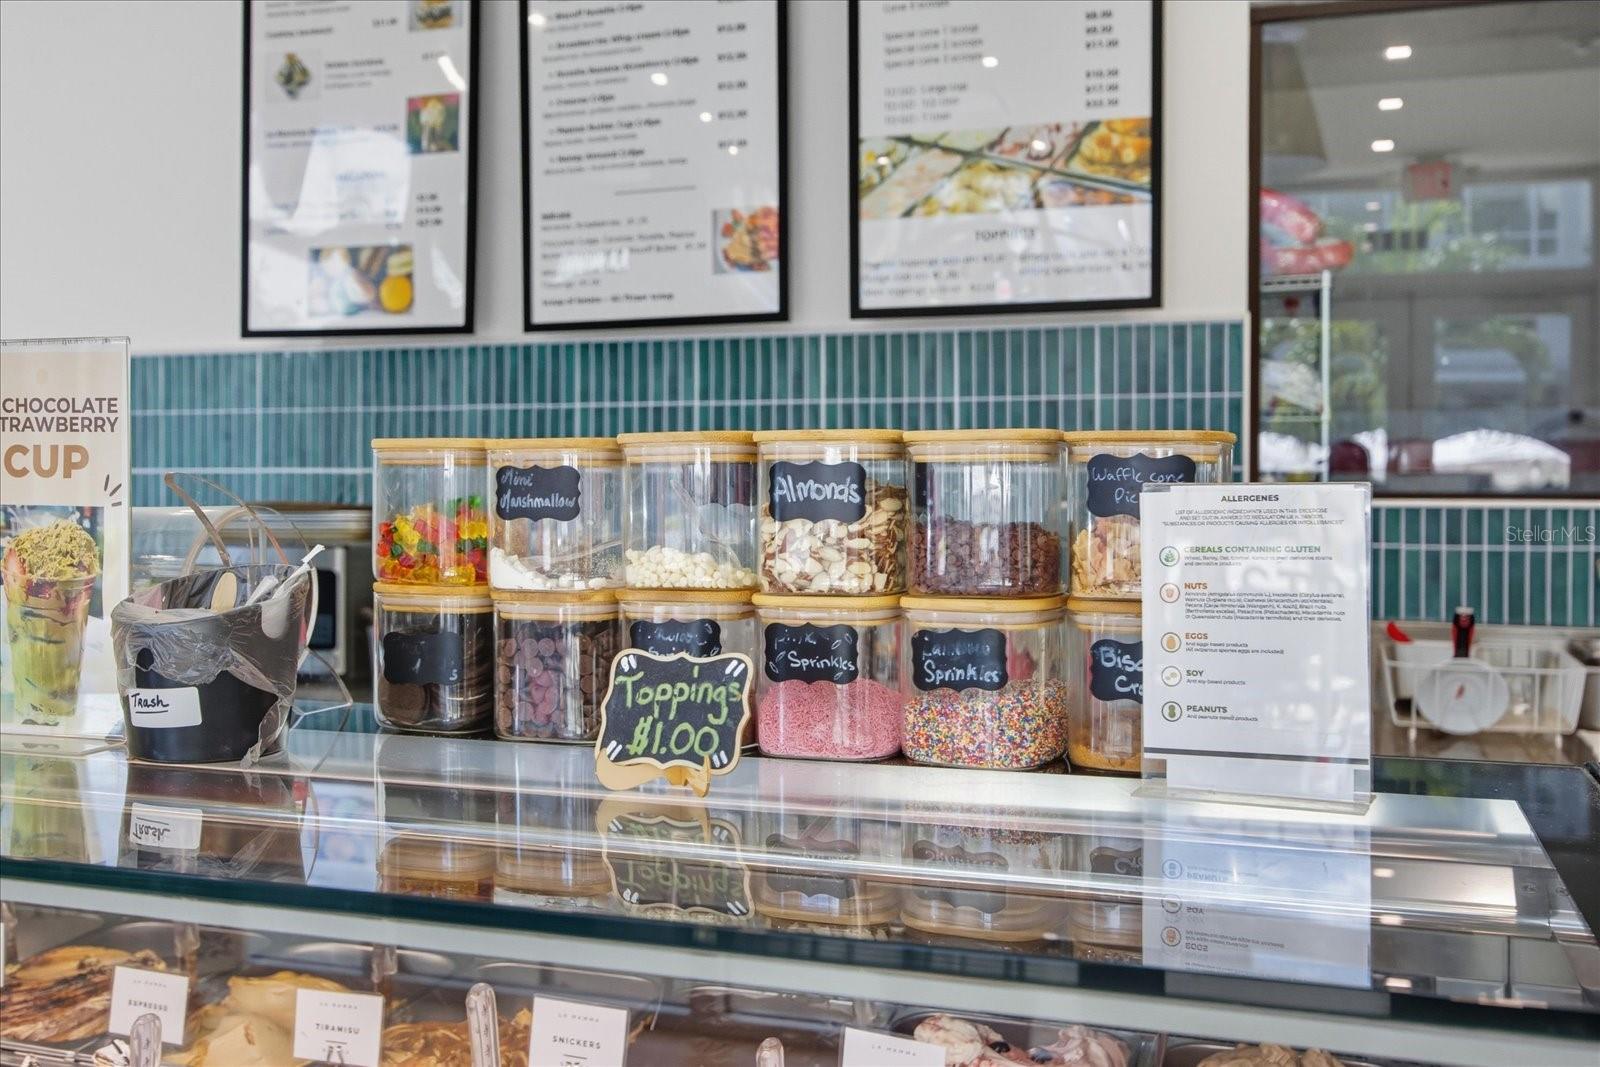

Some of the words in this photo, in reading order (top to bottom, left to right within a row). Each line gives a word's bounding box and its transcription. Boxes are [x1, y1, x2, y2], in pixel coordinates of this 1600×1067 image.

[2, 397, 118, 413] CHOCOLATE
[4, 444, 89, 478] CUP
[1092, 467, 1143, 483] Waffle
[774, 474, 861, 503] Almonds
[1221, 494, 1279, 502] ALLERGENES
[788, 650, 855, 671] Sprinkles
[615, 665, 742, 725] Toppings
[1186, 705, 1228, 713] PEANUTS
[626, 715, 719, 756] $1.00
[315, 1023, 360, 1034] TIRAMISU
[552, 1035, 601, 1049] SNICKERS
